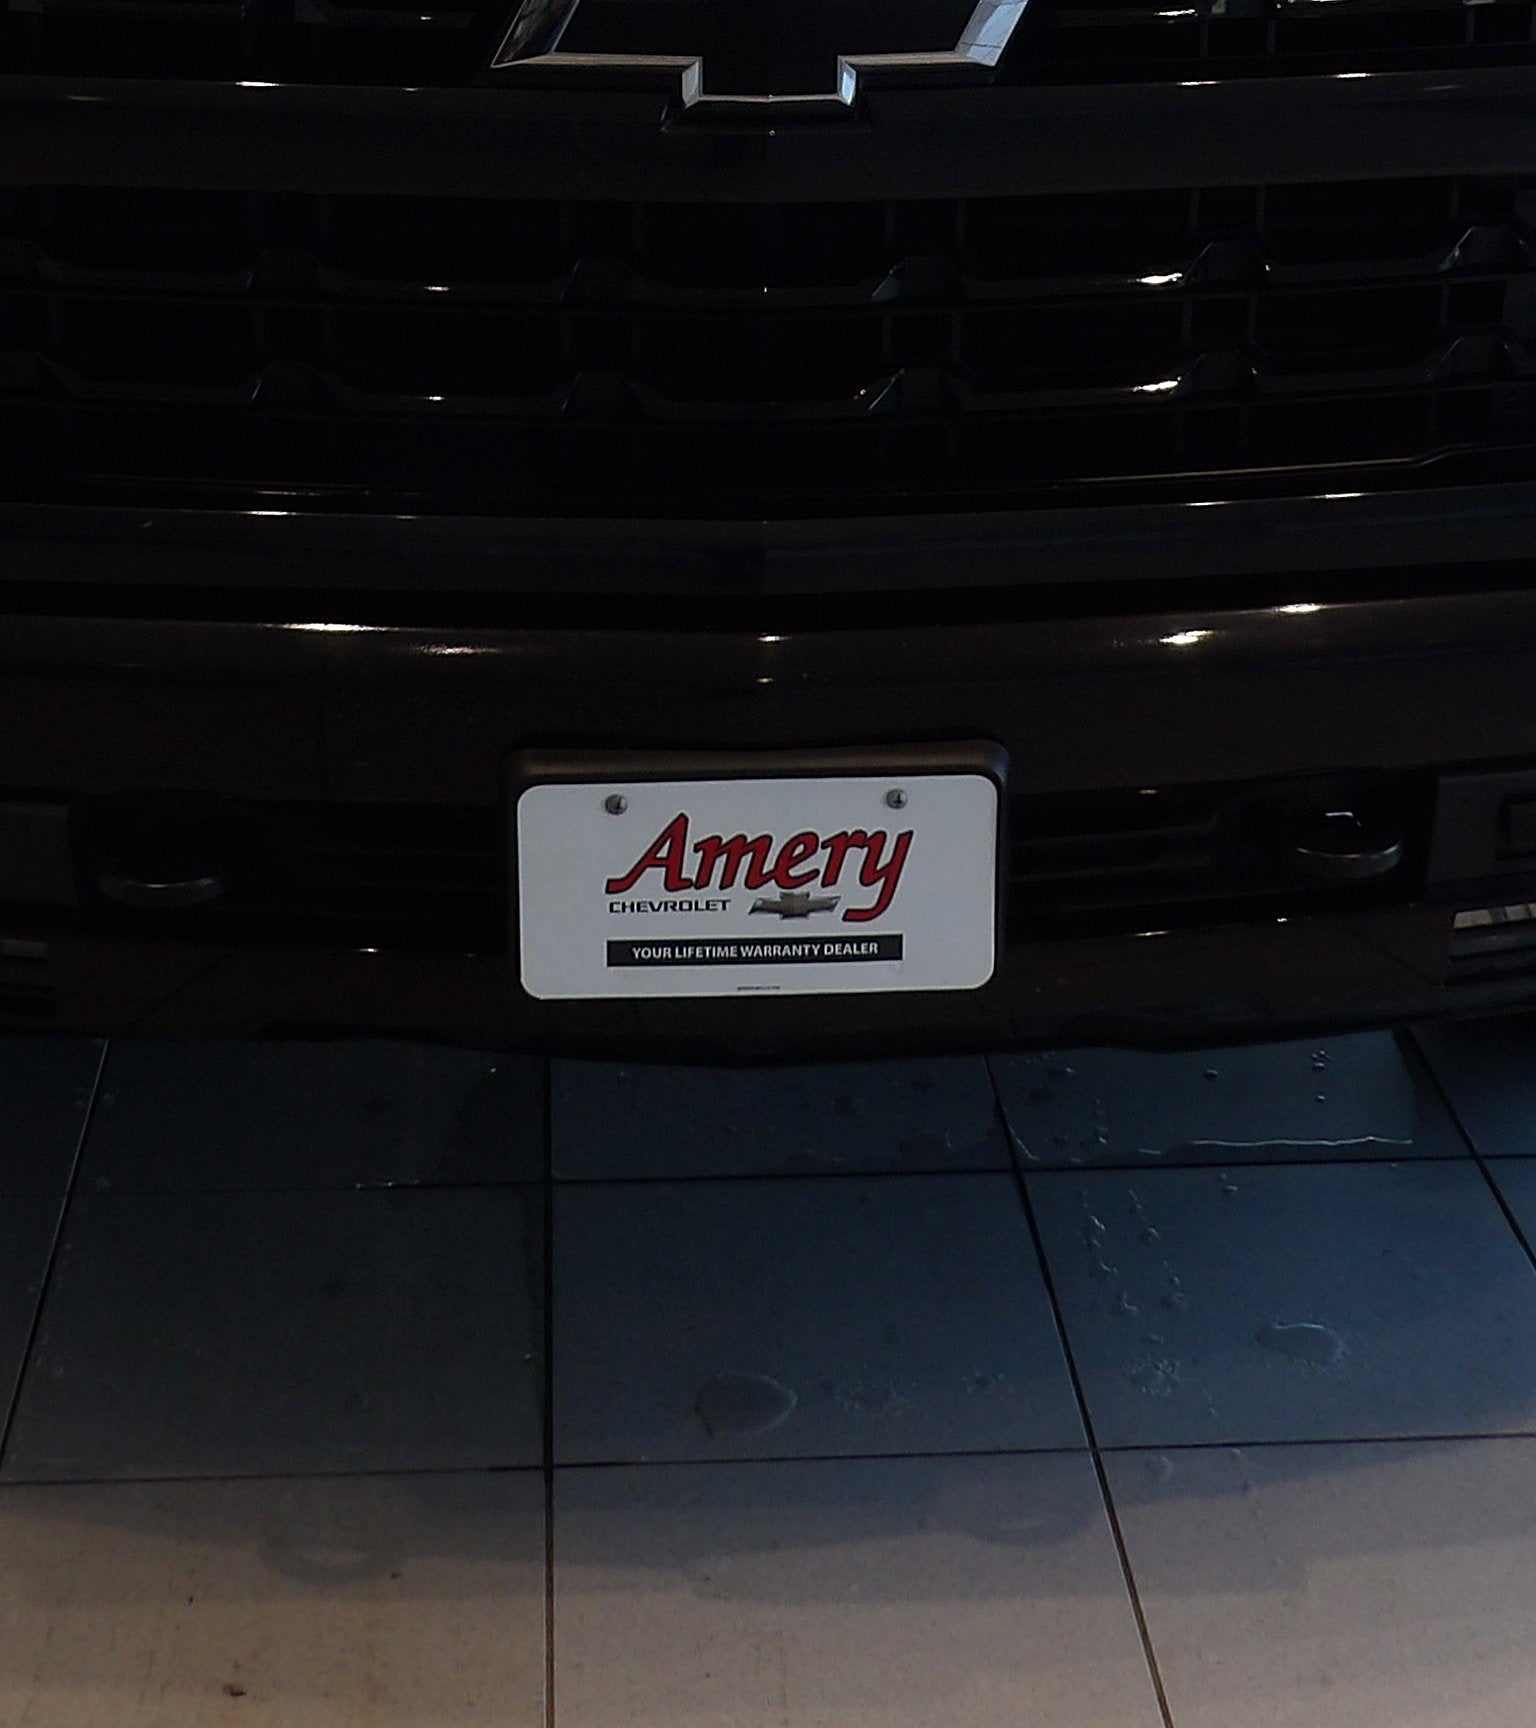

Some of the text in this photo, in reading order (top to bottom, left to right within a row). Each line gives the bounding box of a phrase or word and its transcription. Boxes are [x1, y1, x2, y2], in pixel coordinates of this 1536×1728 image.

[604, 812, 915, 922] Amery
[608, 898, 732, 914] CHEVROLET
[631, 941, 879, 960] YOUR LIFETIME WARRANTY DEALER
